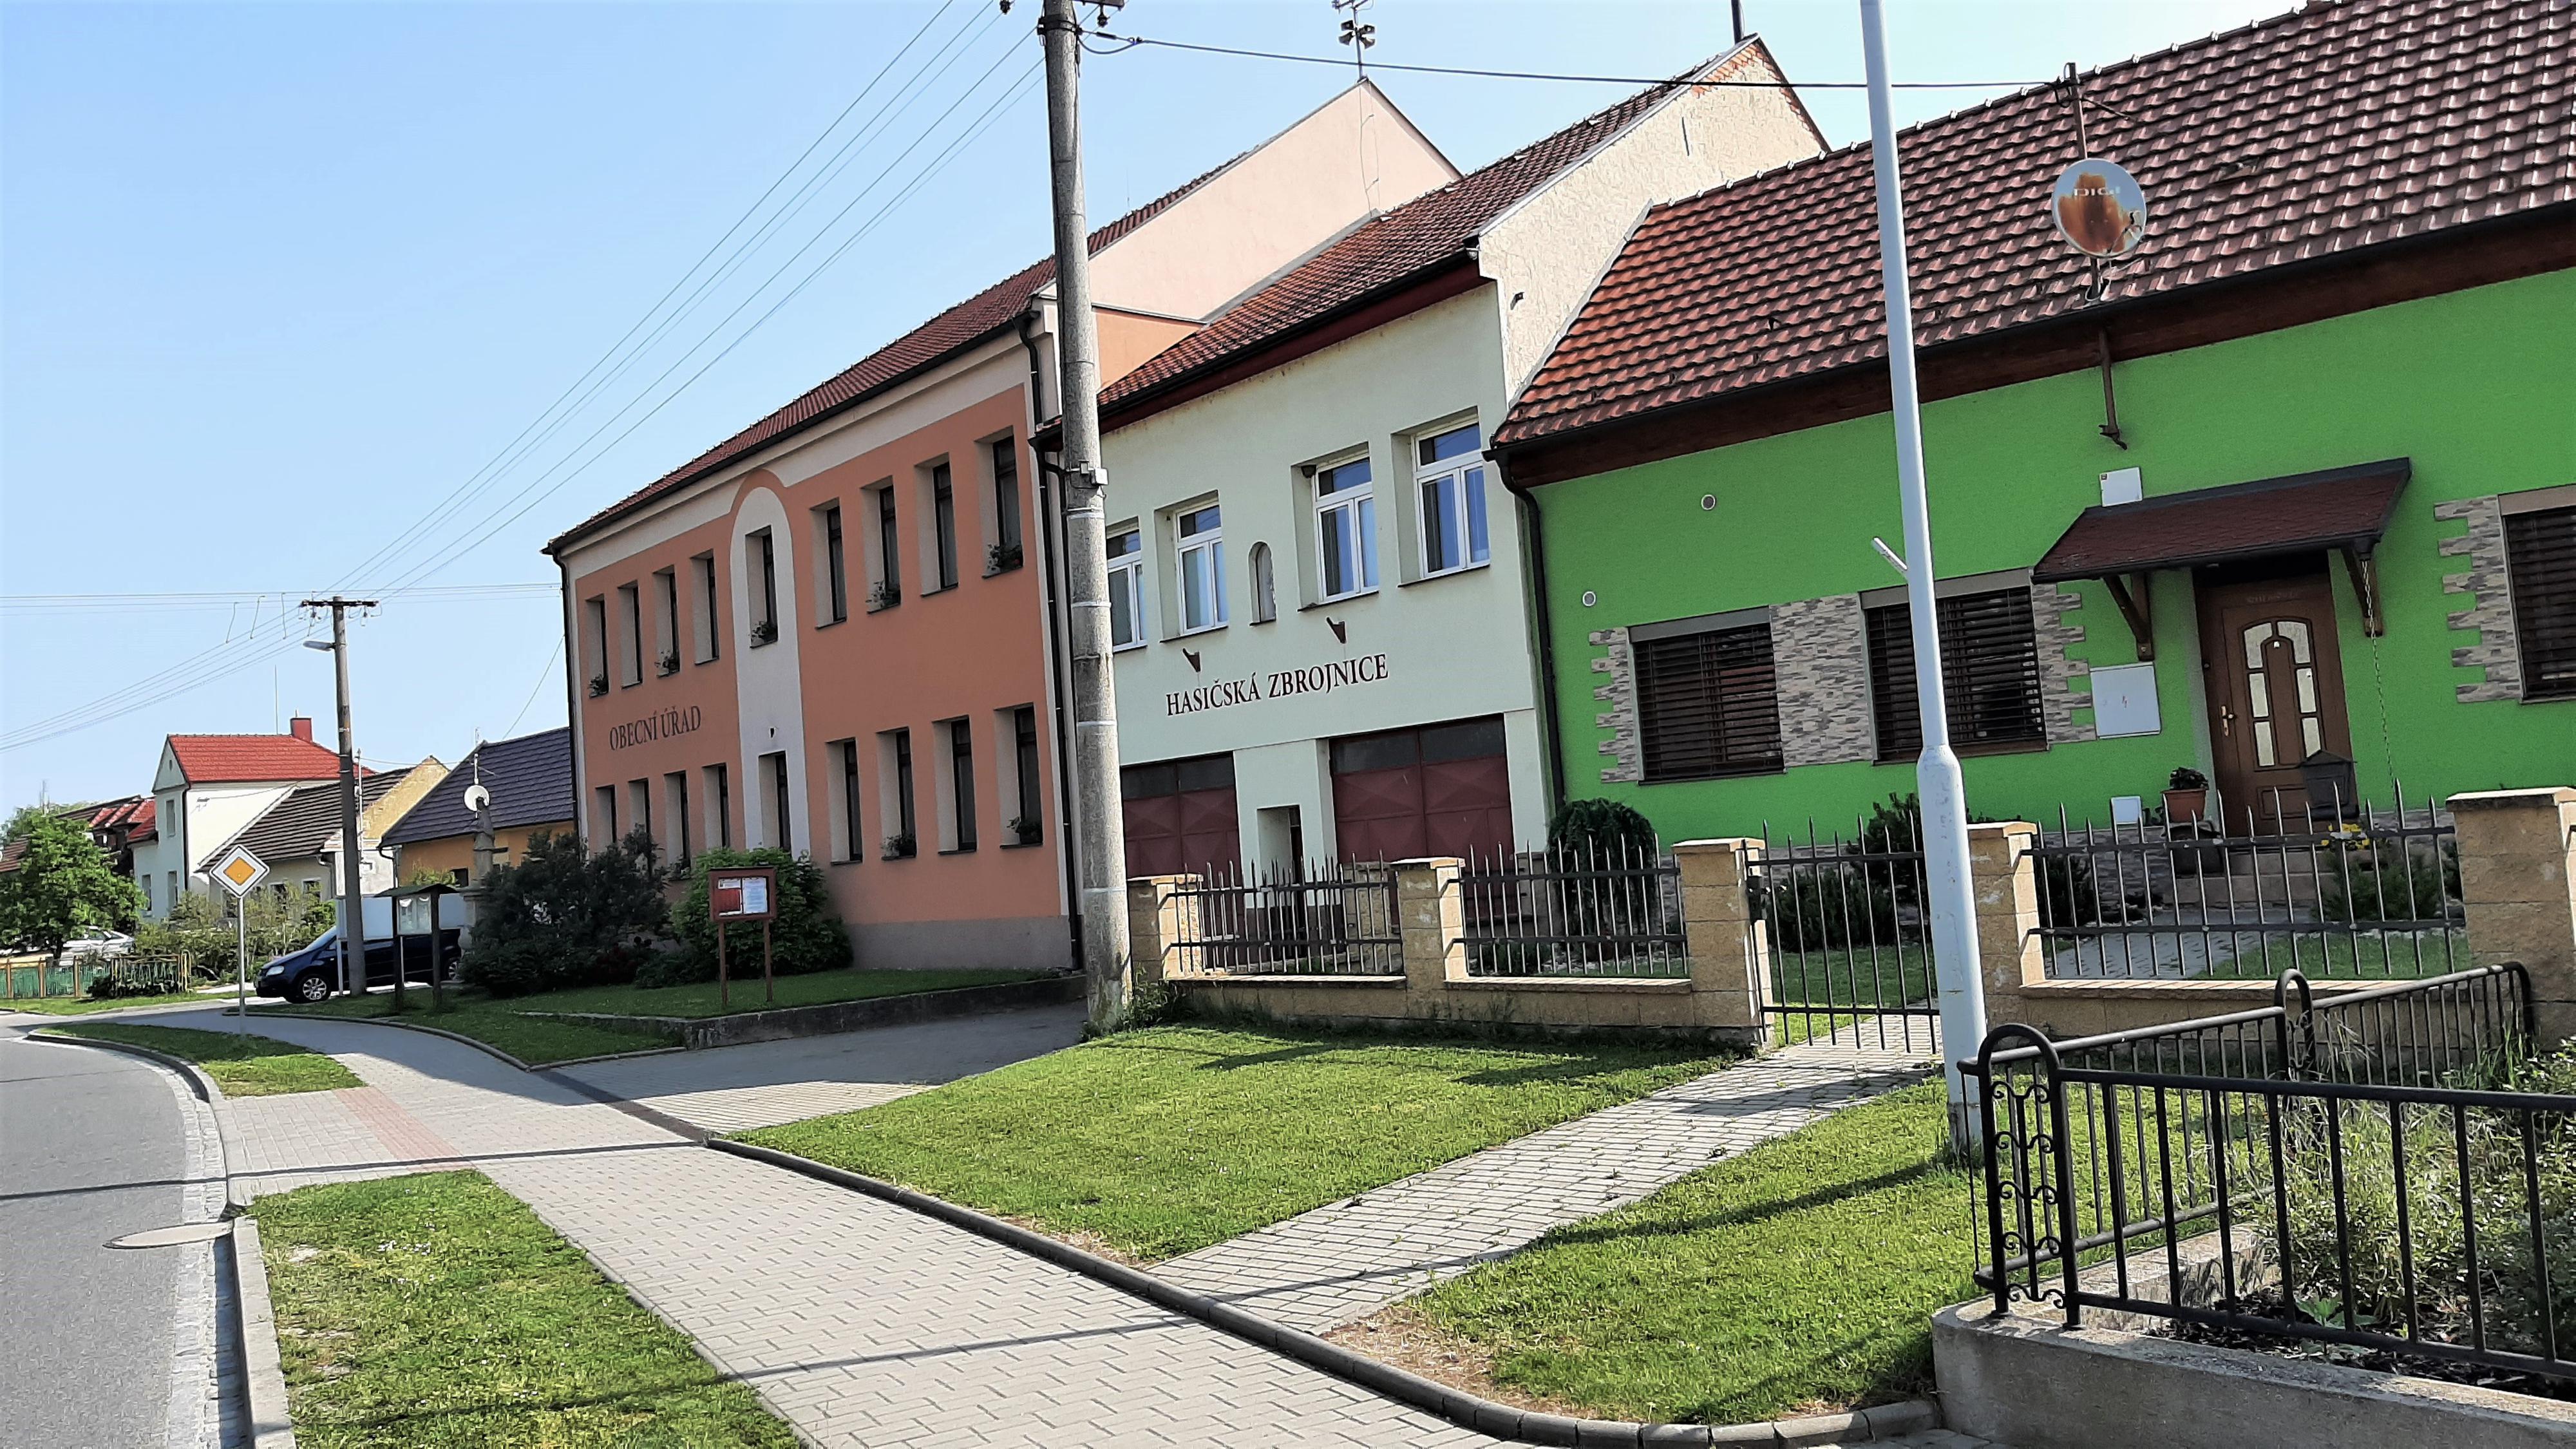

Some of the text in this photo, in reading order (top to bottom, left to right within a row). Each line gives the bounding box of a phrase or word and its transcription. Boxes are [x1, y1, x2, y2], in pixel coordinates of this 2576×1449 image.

[1166, 653, 1388, 716] HASIČSKÁ ZBROJNICE
[609, 705, 701, 751] OBECNÍ ÚŘAD
